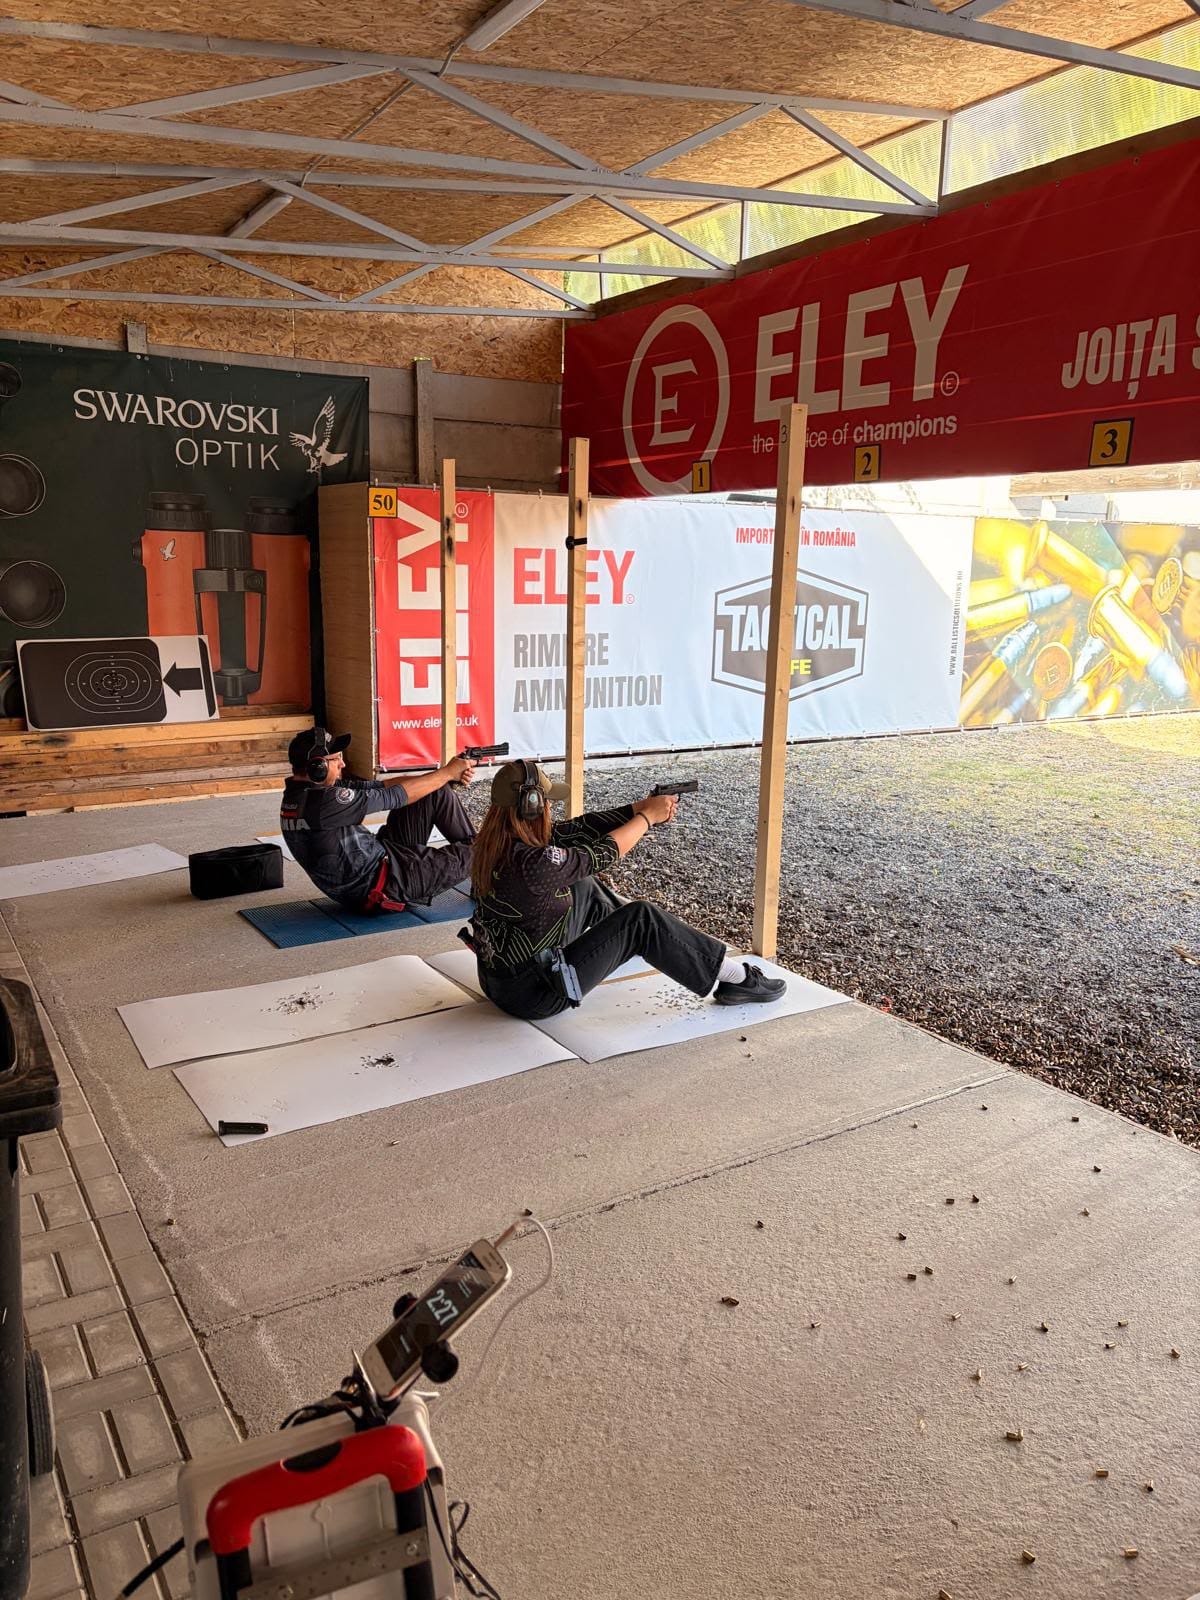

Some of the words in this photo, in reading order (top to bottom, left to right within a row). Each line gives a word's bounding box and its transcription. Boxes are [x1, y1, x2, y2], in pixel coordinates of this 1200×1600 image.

[754, 264, 970, 423] ELEY
[1061, 314, 1177, 400] JOIȚA
[73, 388, 280, 436] SWAROVSKI
[649, 358, 698, 446] E
[752, 433, 774, 454] the
[832, 422, 849, 446] of
[853, 414, 958, 444] champions
[780, 424, 788, 444] 3
[1100, 428, 1119, 459] 3
[175, 437, 280, 471] OPTIK
[861, 451, 872, 476] 2
[698, 467, 705, 488] 1
[372, 494, 394, 511] 50
[735, 527, 775, 544] IMPORT
[800, 526, 811, 546] ÎN
[813, 527, 856, 547] ROMÂNIA
[513, 548, 635, 605] ELEY
[397, 499, 470, 707] ELEY
[717, 603, 864, 652] TAICAL
[513, 633, 609, 668] RIMRE
[392, 714, 479, 730] www.eleo.uk
